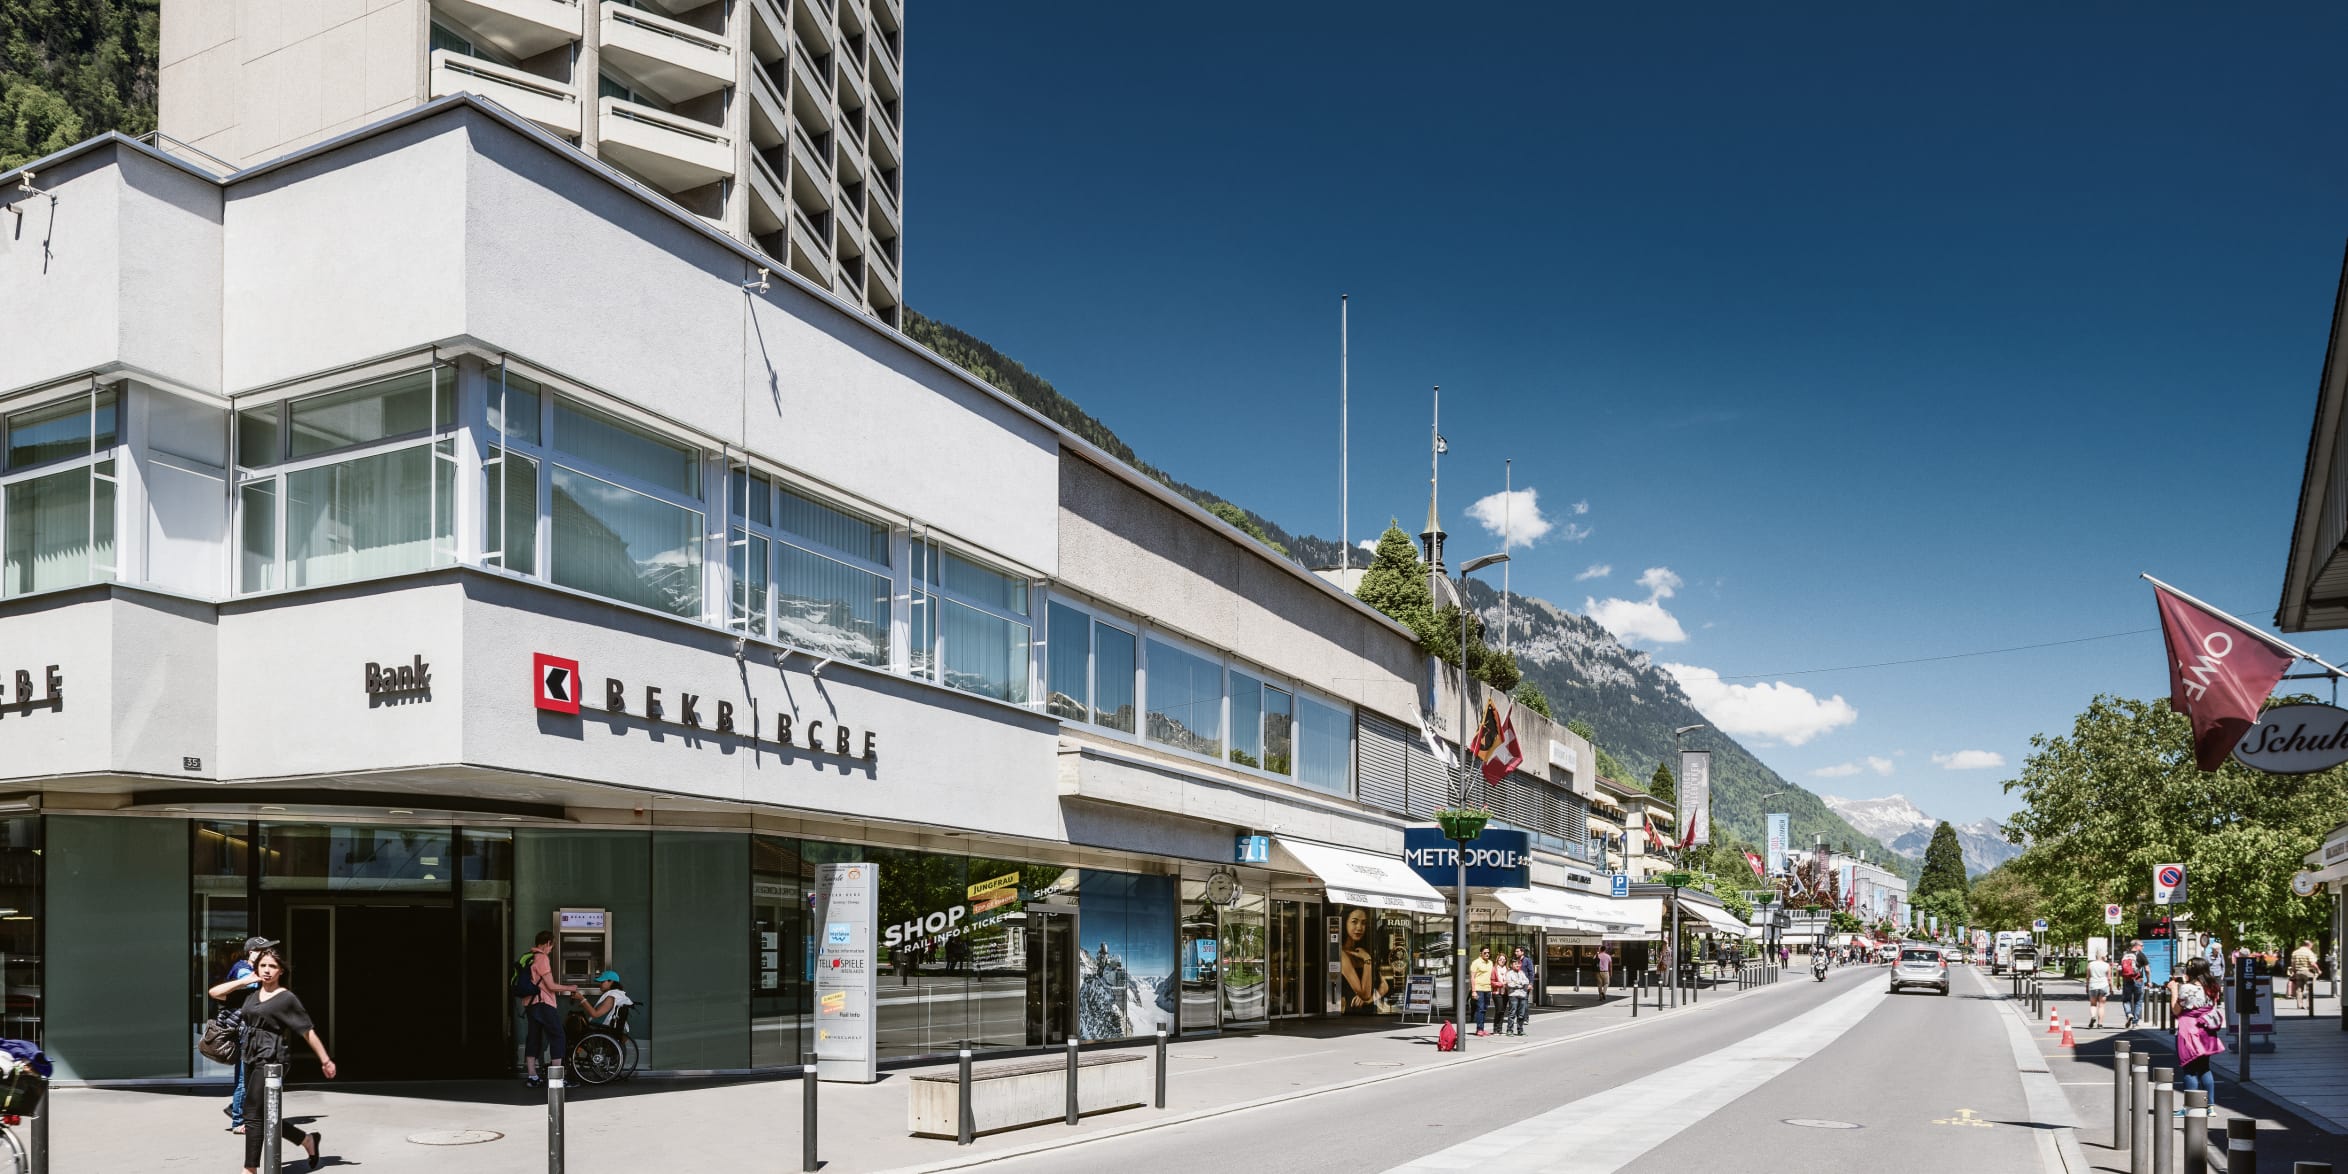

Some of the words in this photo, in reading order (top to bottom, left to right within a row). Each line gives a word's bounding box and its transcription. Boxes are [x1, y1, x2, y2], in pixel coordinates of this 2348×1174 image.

[0, 664, 62, 702] BE
[365, 654, 431, 694] Bank
[606, 677, 735, 732] BEKB
[777, 712, 877, 759] BCBE
[186, 758, 199, 768] 35
[1404, 848, 1516, 868] METROPOLE
[973, 876, 1014, 895] JUNGFRAU
[1033, 885, 1060, 898] SHOP
[1616, 876, 1624, 887] P
[883, 905, 966, 947] SHOP
[904, 941, 930, 954] RAIL
[934, 928, 961, 945] INFO
[962, 925, 970, 934] &
[819, 959, 831, 968] TELL
[840, 959, 864, 969] SPIELE
